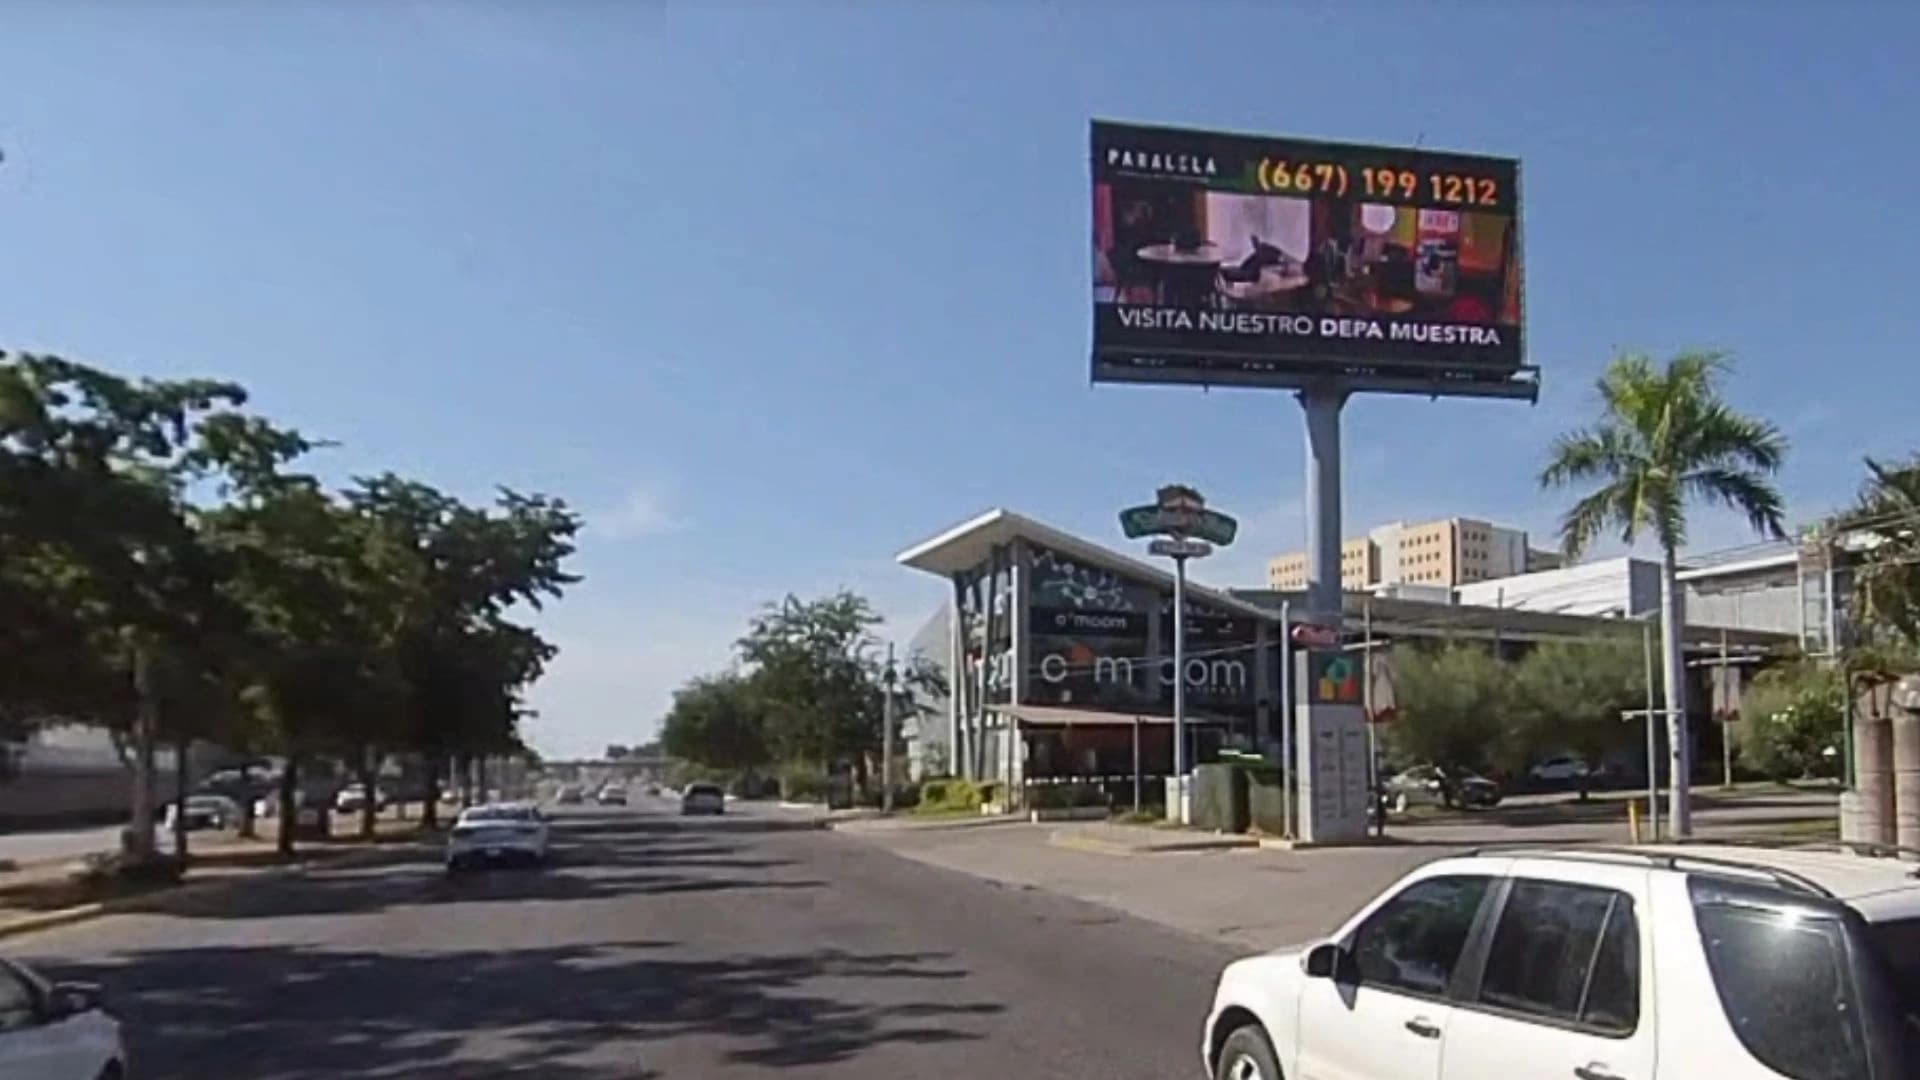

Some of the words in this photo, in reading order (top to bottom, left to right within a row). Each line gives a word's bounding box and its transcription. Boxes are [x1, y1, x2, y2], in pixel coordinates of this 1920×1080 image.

[1107, 149, 1217, 175] PARALELA
[1257, 156, 1348, 198] (667)
[1362, 166, 1418, 199] 199
[1430, 173, 1498, 206] 1212
[1117, 306, 1193, 330] VISITA
[1199, 310, 1314, 336] NUESTRO
[1320, 317, 1384, 341] DEPA
[1390, 321, 1502, 346] MUESTRA
